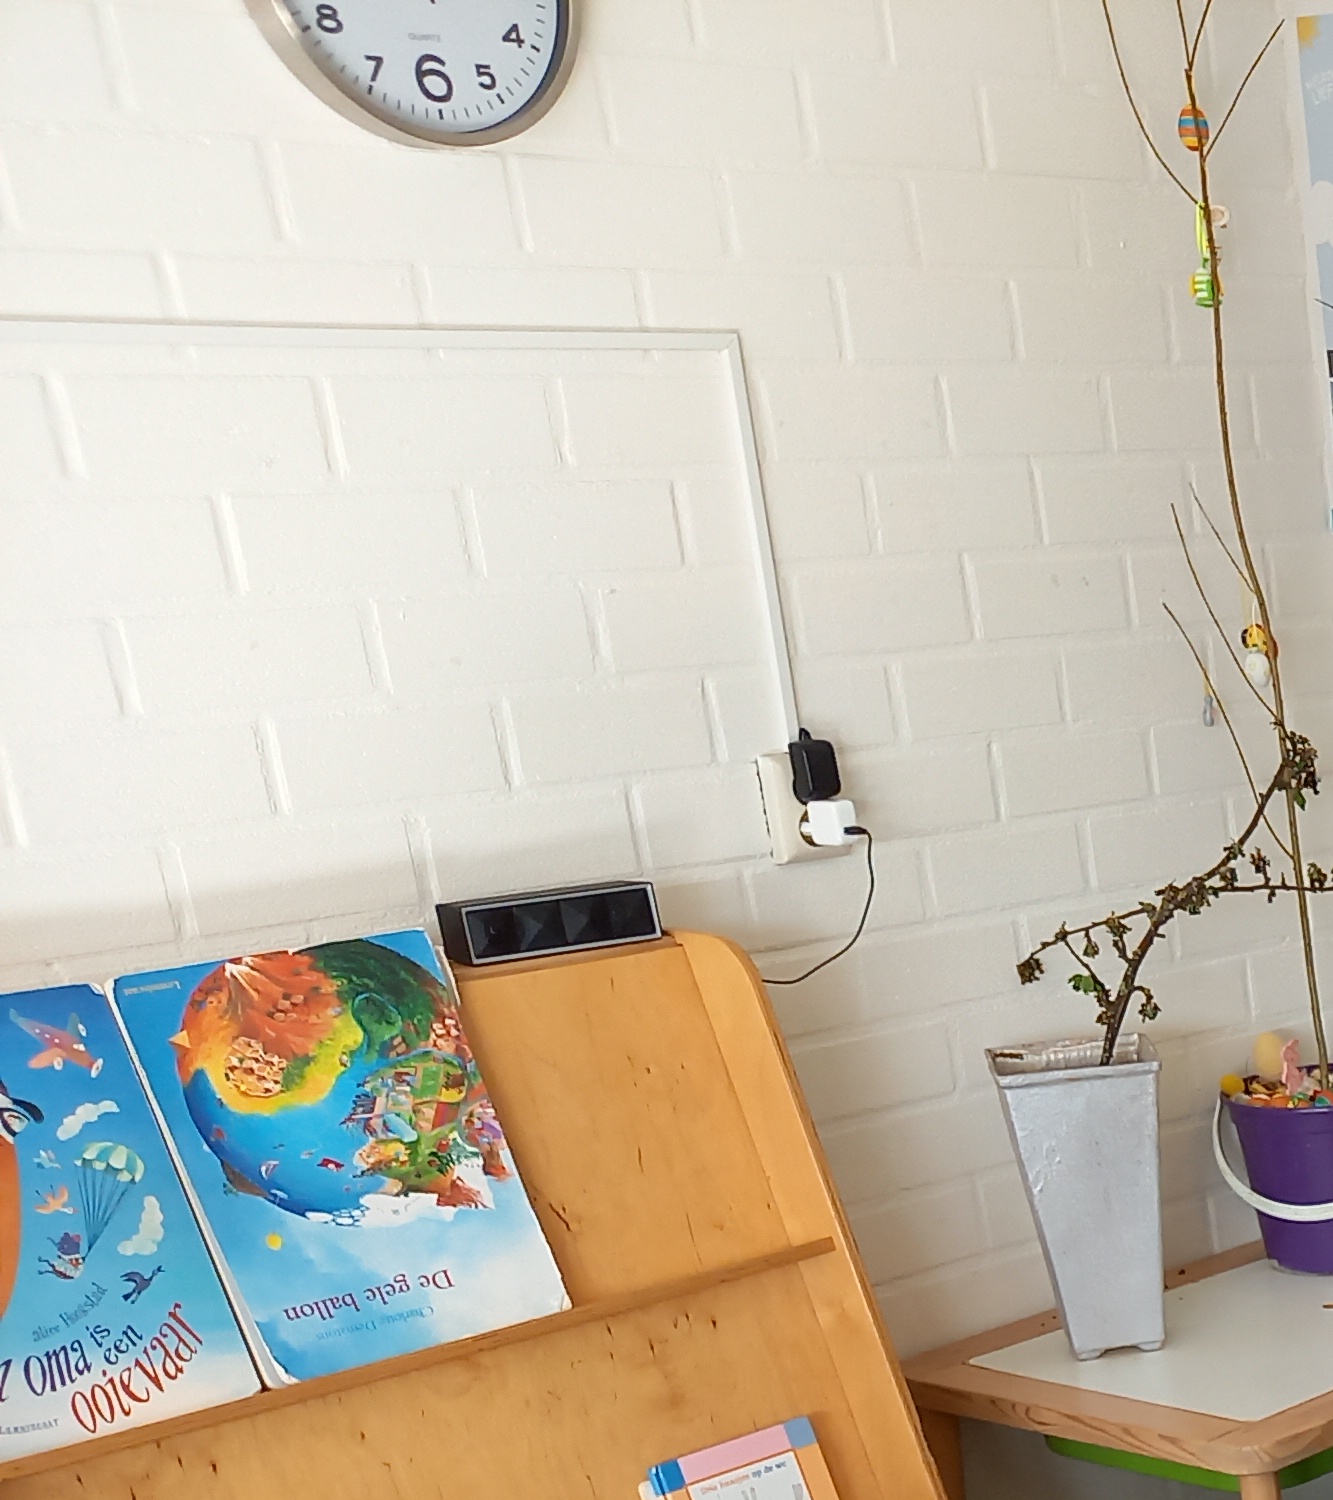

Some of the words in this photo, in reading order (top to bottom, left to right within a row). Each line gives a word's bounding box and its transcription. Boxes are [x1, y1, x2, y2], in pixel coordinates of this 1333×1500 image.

[316, 4, 343, 34] 8
[501, 23, 525, 49] 4
[364, 54, 384, 82] 7
[415, 53, 453, 103] 6
[474, 63, 497, 90] 5
[363, 1273, 410, 1305] gele
[417, 1268, 455, 1291] De
[283, 1292, 360, 1322] ballon
[103, 1324, 143, 1365] een
[23, 1339, 92, 1397] oma
[86, 1324, 111, 1348] is
[71, 1302, 203, 1434] ooievaar
